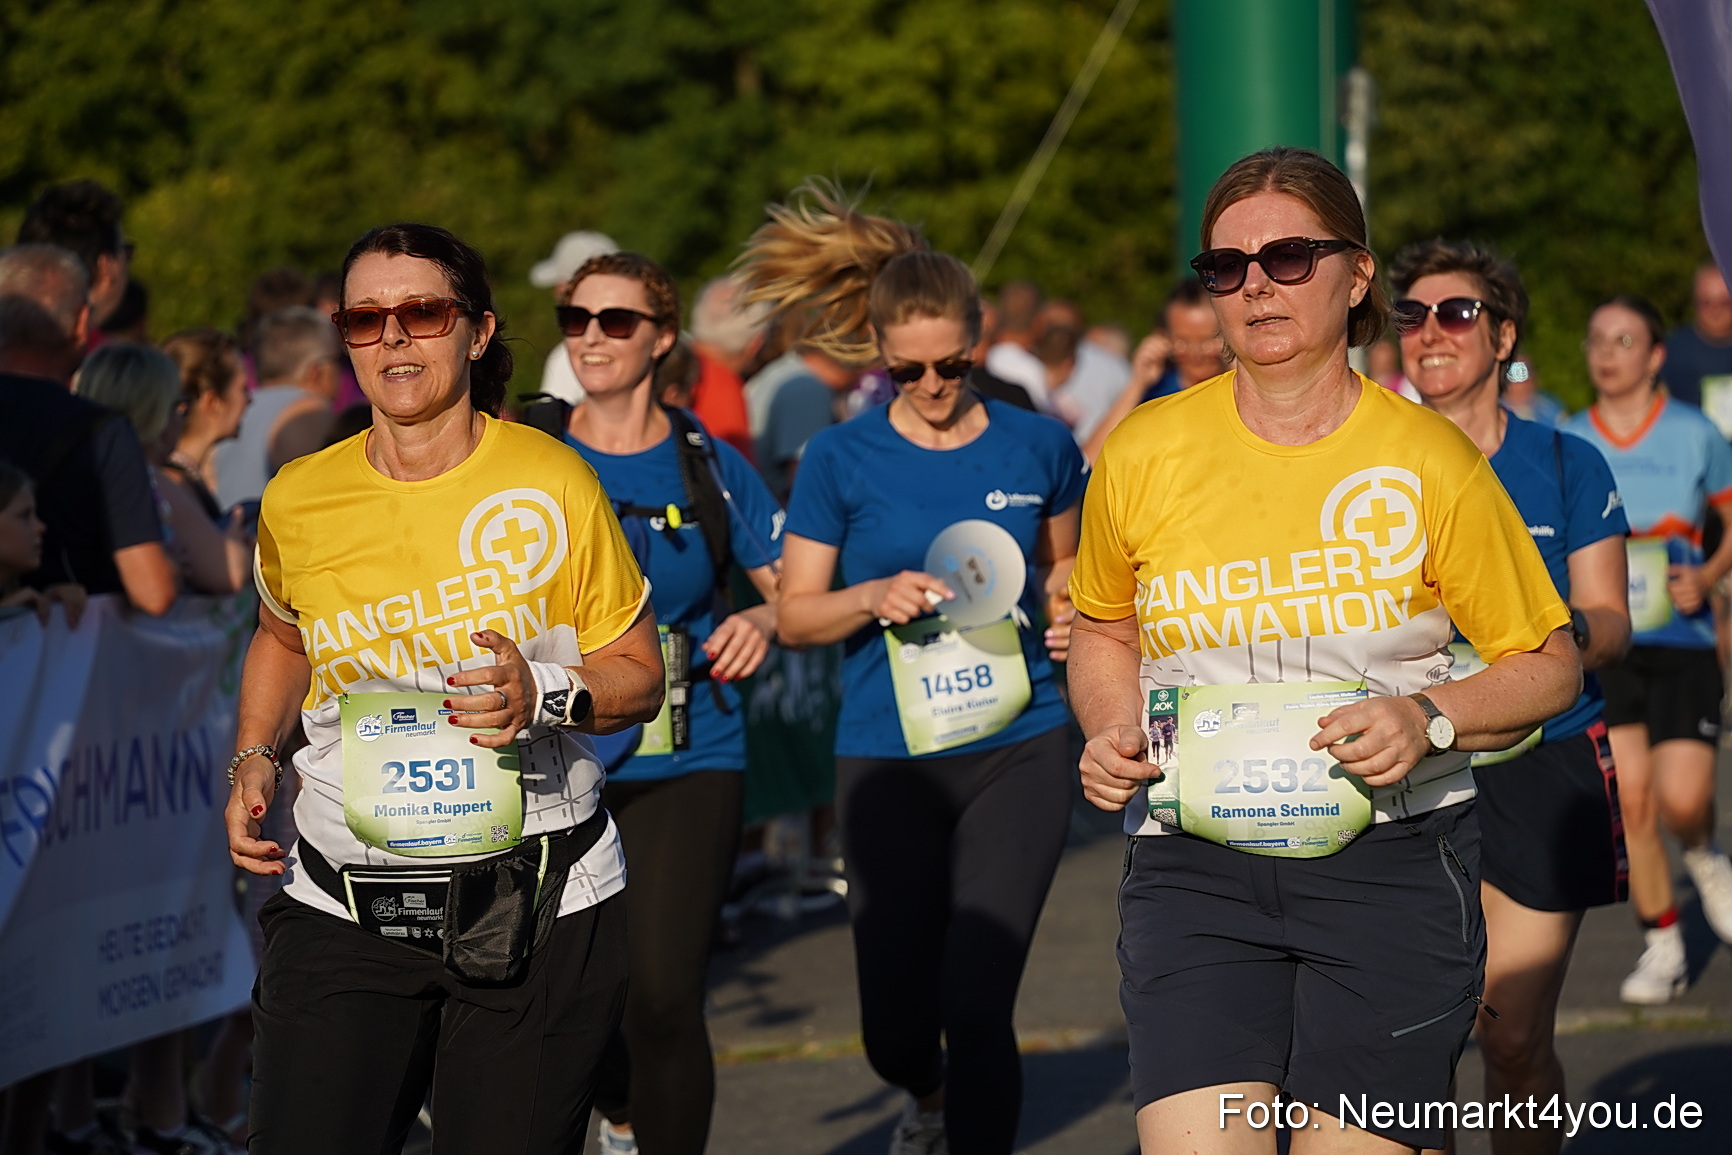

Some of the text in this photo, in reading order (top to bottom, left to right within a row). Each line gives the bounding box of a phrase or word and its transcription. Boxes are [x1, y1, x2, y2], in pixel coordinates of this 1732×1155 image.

[921, 664, 993, 699] 1458
[1152, 701, 1174, 712] AOK
[384, 721, 437, 734] Firmenlauf
[405, 729, 436, 738] neumarkt
[381, 757, 475, 794] 2531
[1213, 757, 1329, 794] 2532
[374, 800, 493, 817] Monika Ruppert
[1211, 803, 1341, 818] Ramona Schmid
[397, 907, 444, 916] Firmenlauf
